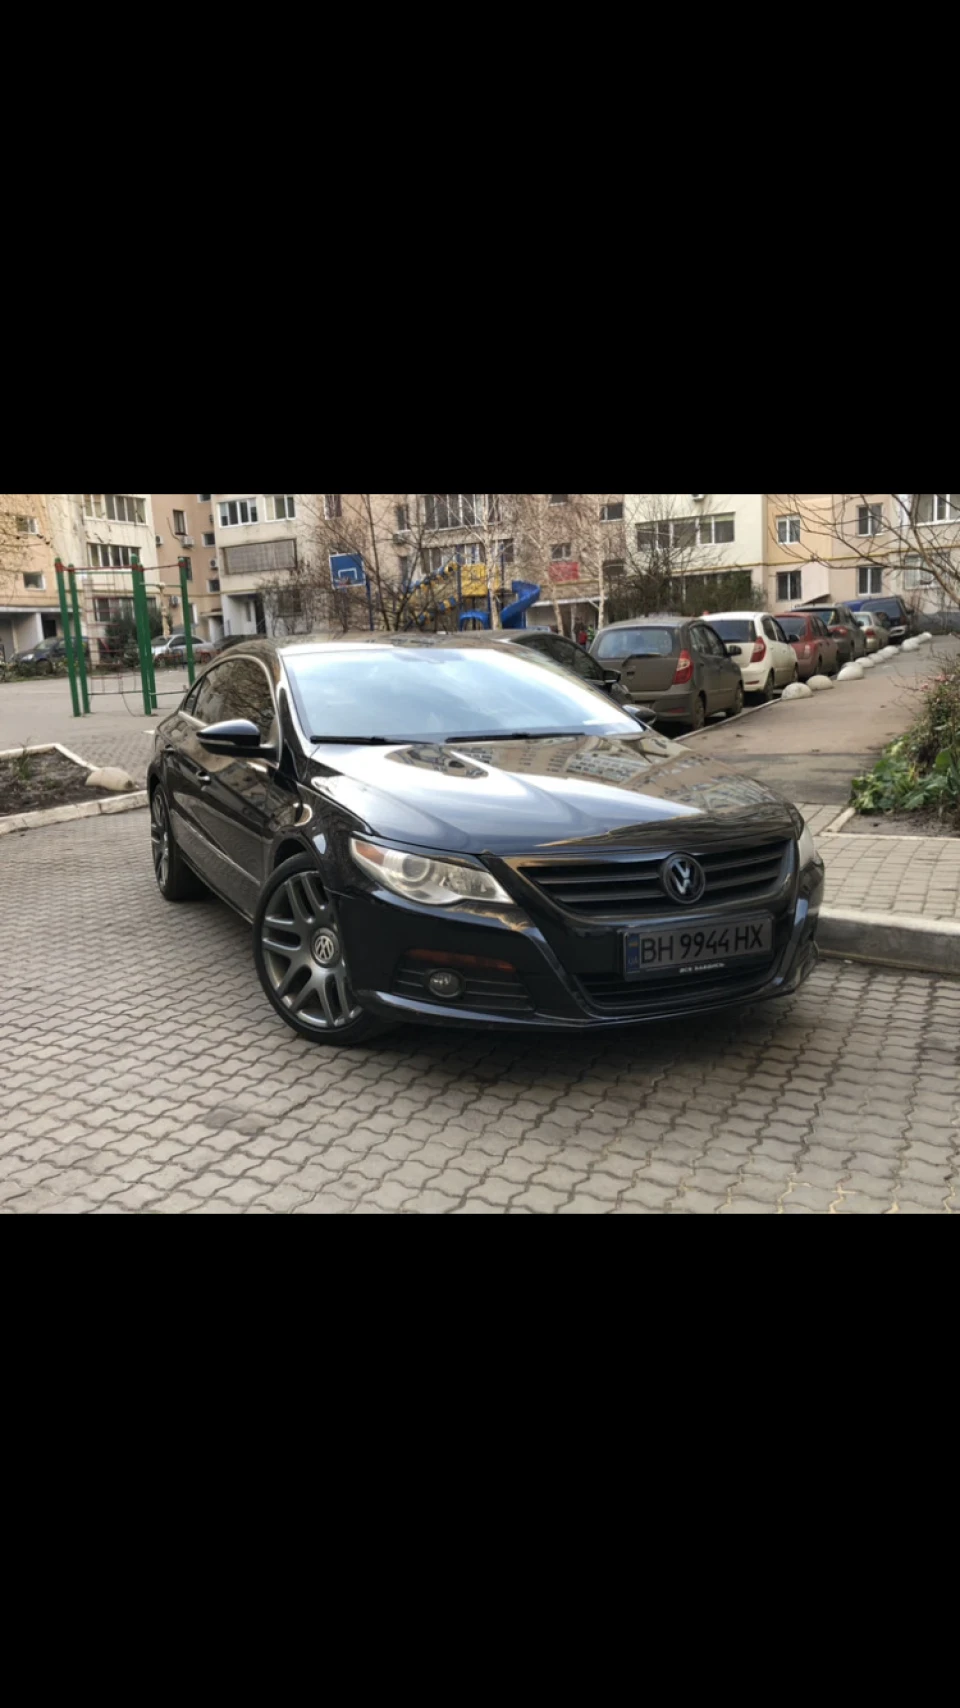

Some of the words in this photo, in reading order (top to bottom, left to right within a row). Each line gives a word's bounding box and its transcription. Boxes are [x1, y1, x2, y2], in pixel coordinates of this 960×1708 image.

[641, 935, 673, 964] BH
[680, 928, 730, 959] 9944
[735, 924, 764, 952] HX
